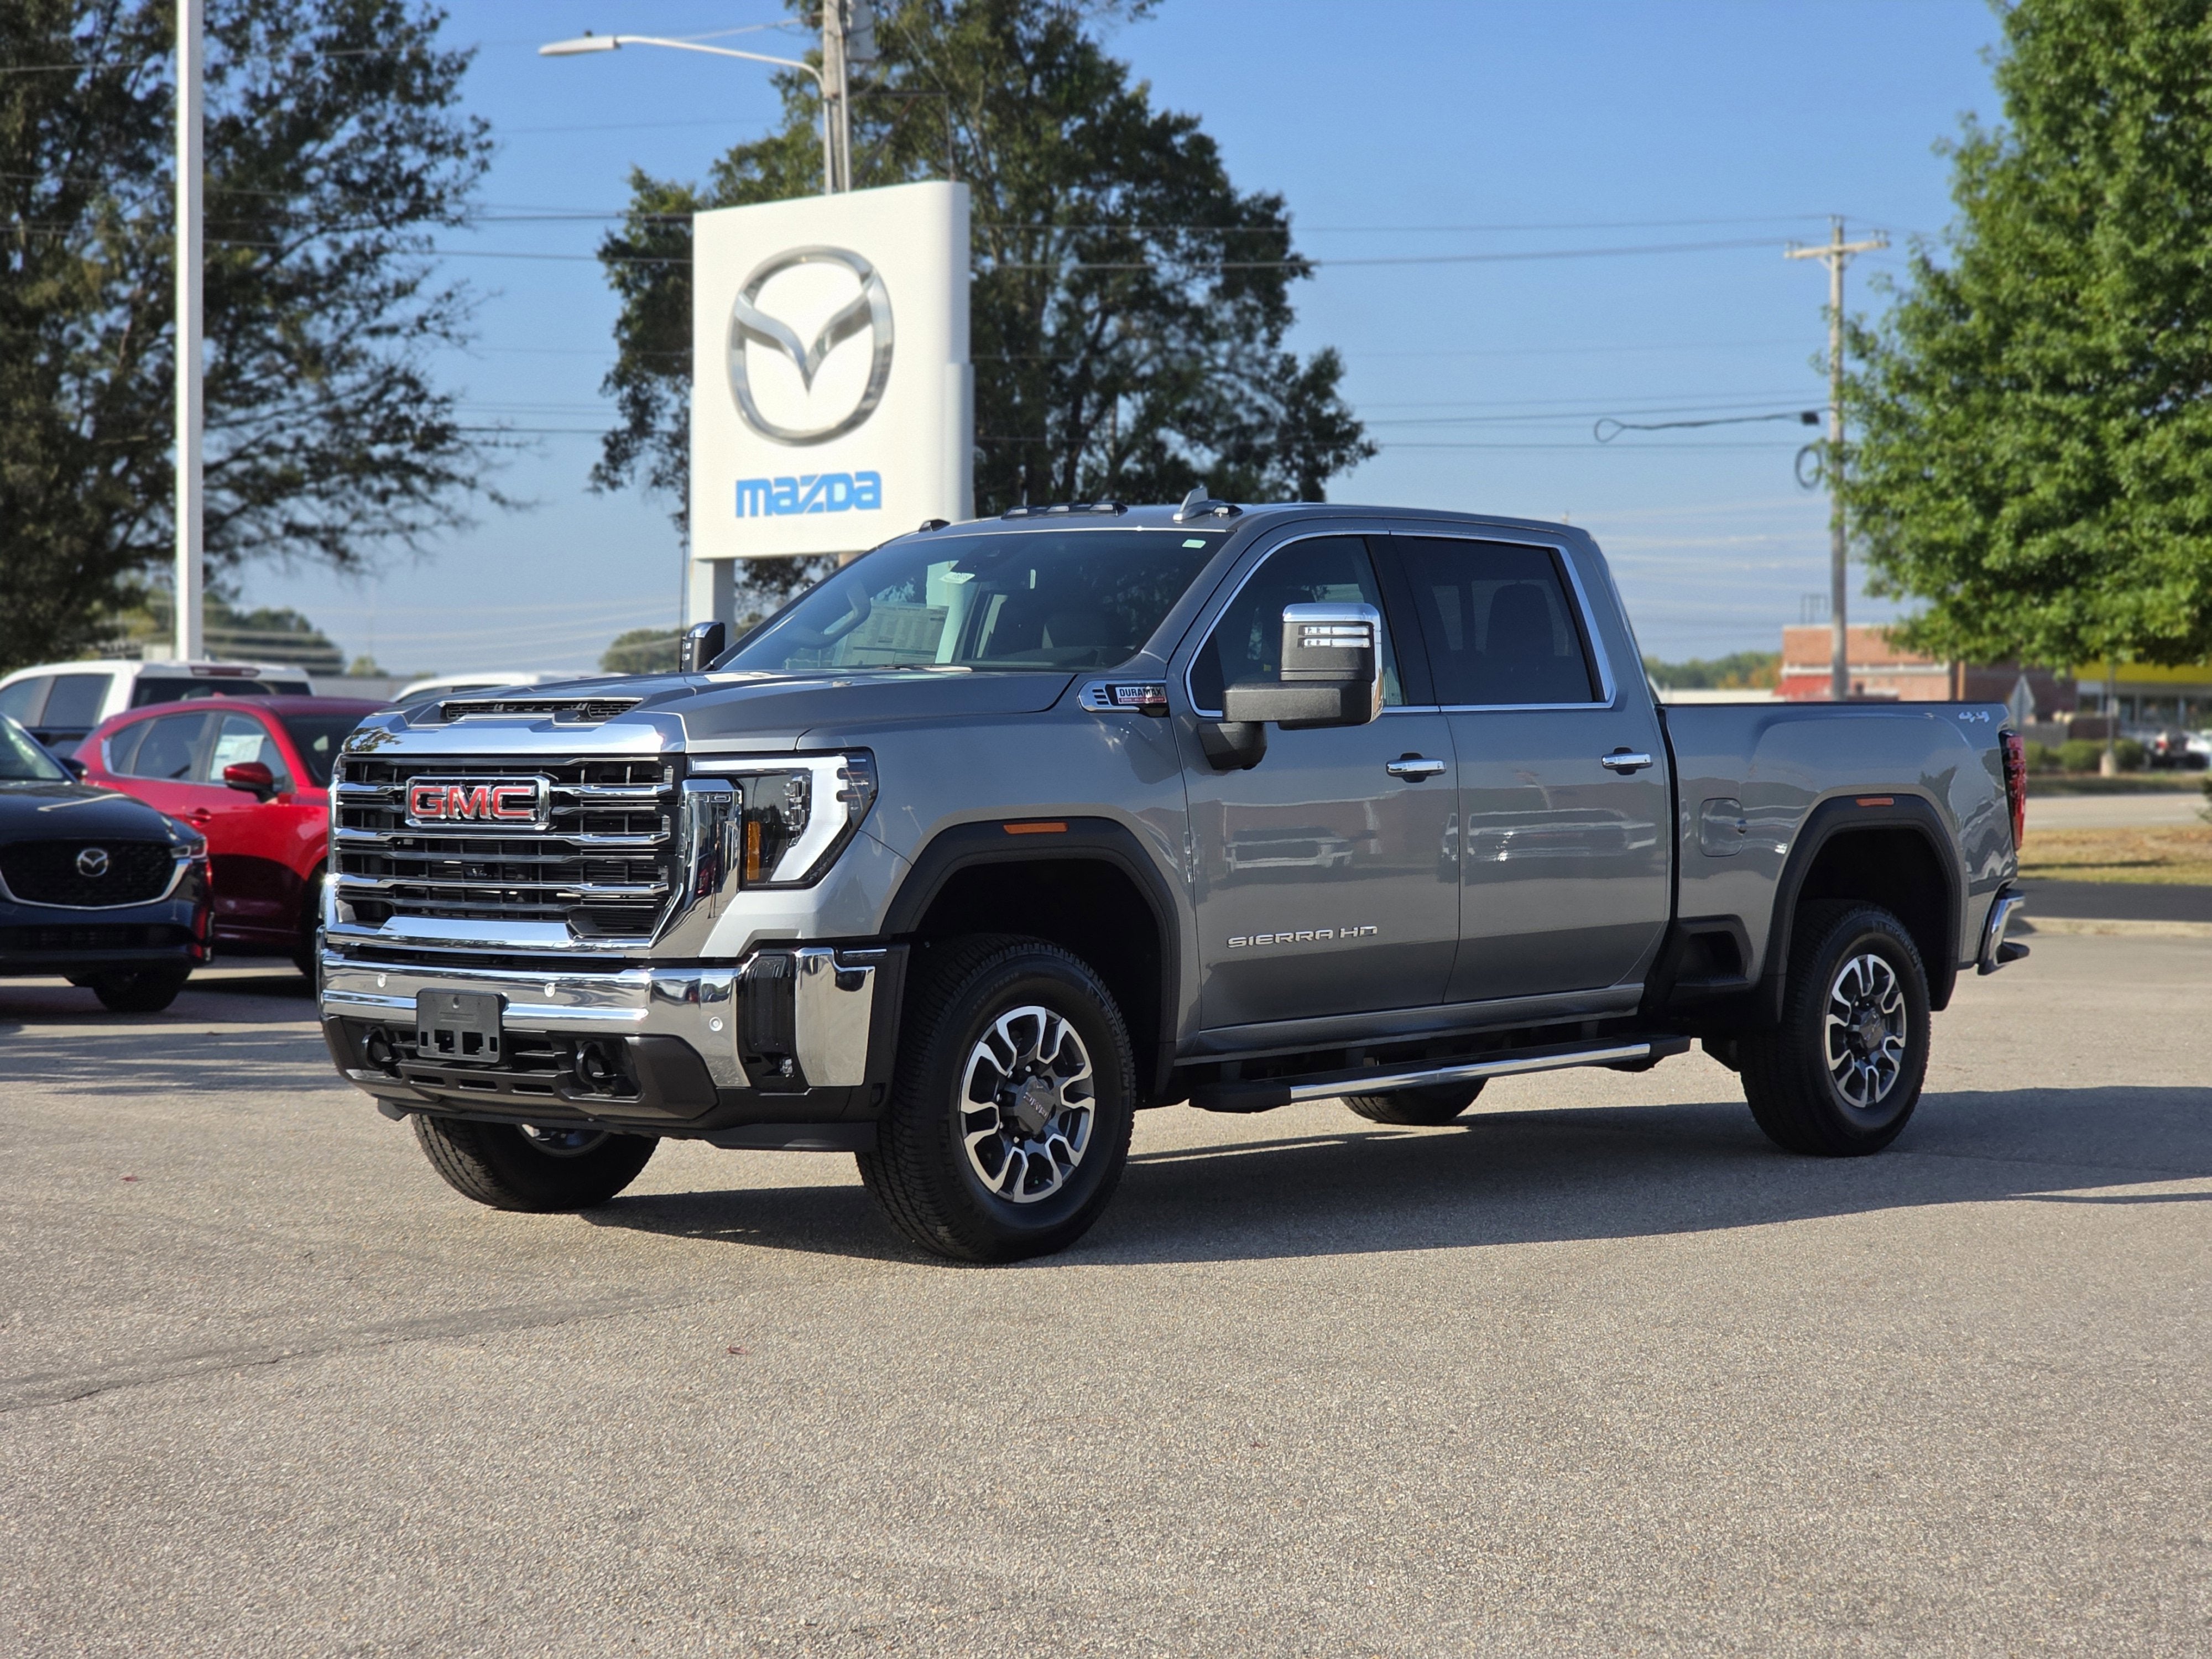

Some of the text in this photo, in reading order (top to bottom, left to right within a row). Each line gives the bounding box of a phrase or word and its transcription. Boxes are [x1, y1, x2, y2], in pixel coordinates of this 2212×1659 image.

[1119, 688, 1162, 697] DURAMAX
[410, 785, 536, 821] GMC
[1228, 926, 1378, 948] SIERRA HD
[1100, 1004, 1130, 1088] MICHELIN
